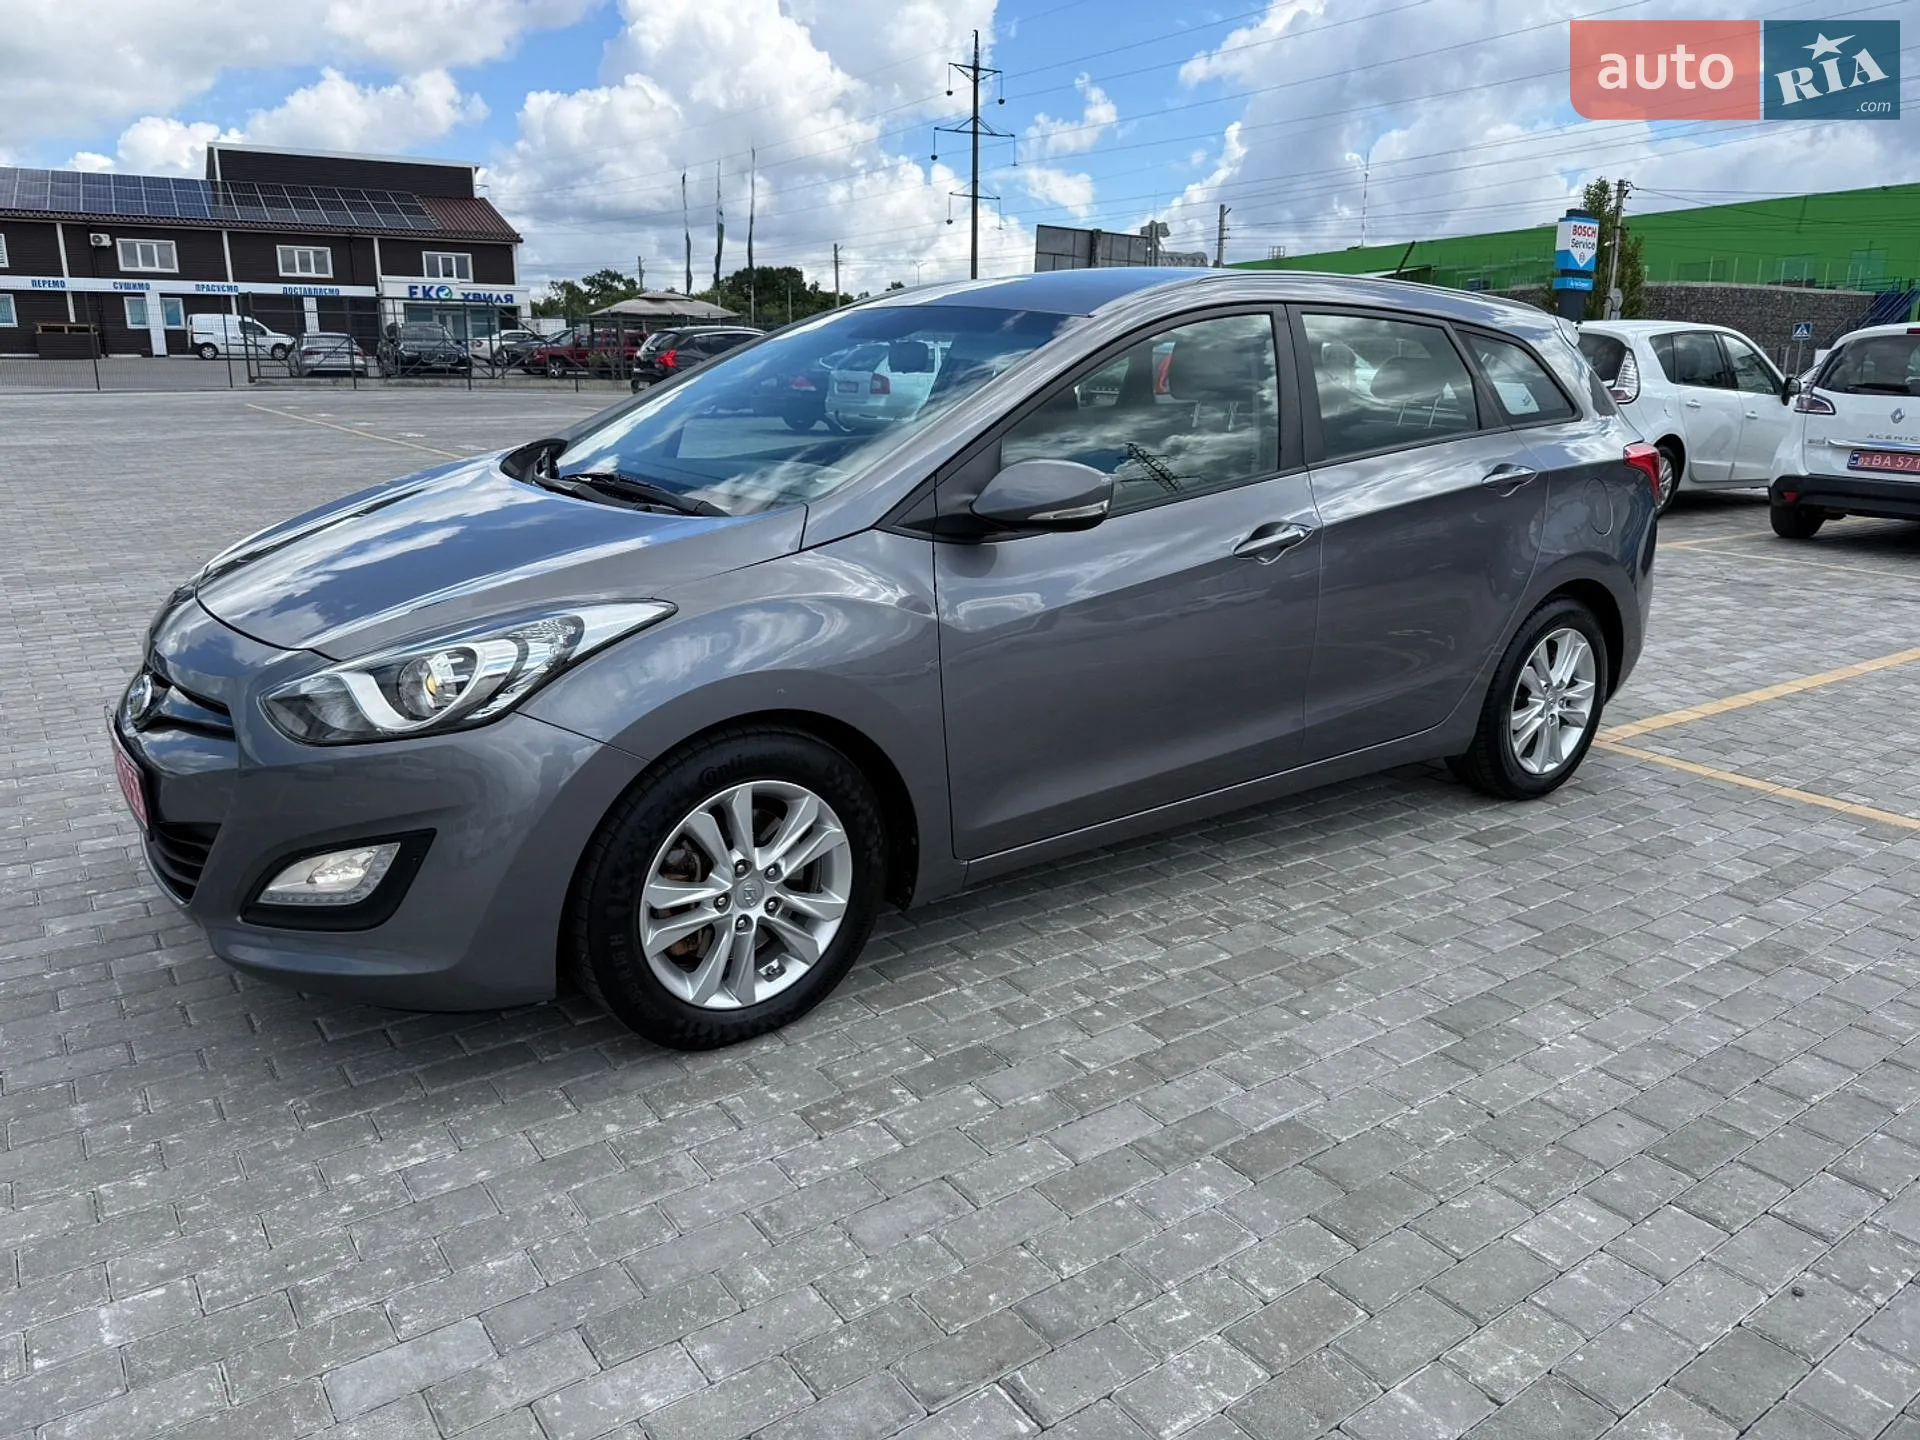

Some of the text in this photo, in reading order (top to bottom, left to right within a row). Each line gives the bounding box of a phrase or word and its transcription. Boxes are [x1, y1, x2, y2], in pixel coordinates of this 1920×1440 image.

[1572, 224, 1596, 238] BOSCH
[1571, 238, 1595, 250] Service
[31, 279, 66, 288] ПЕРЕМО
[113, 281, 150, 290] СУШИМО
